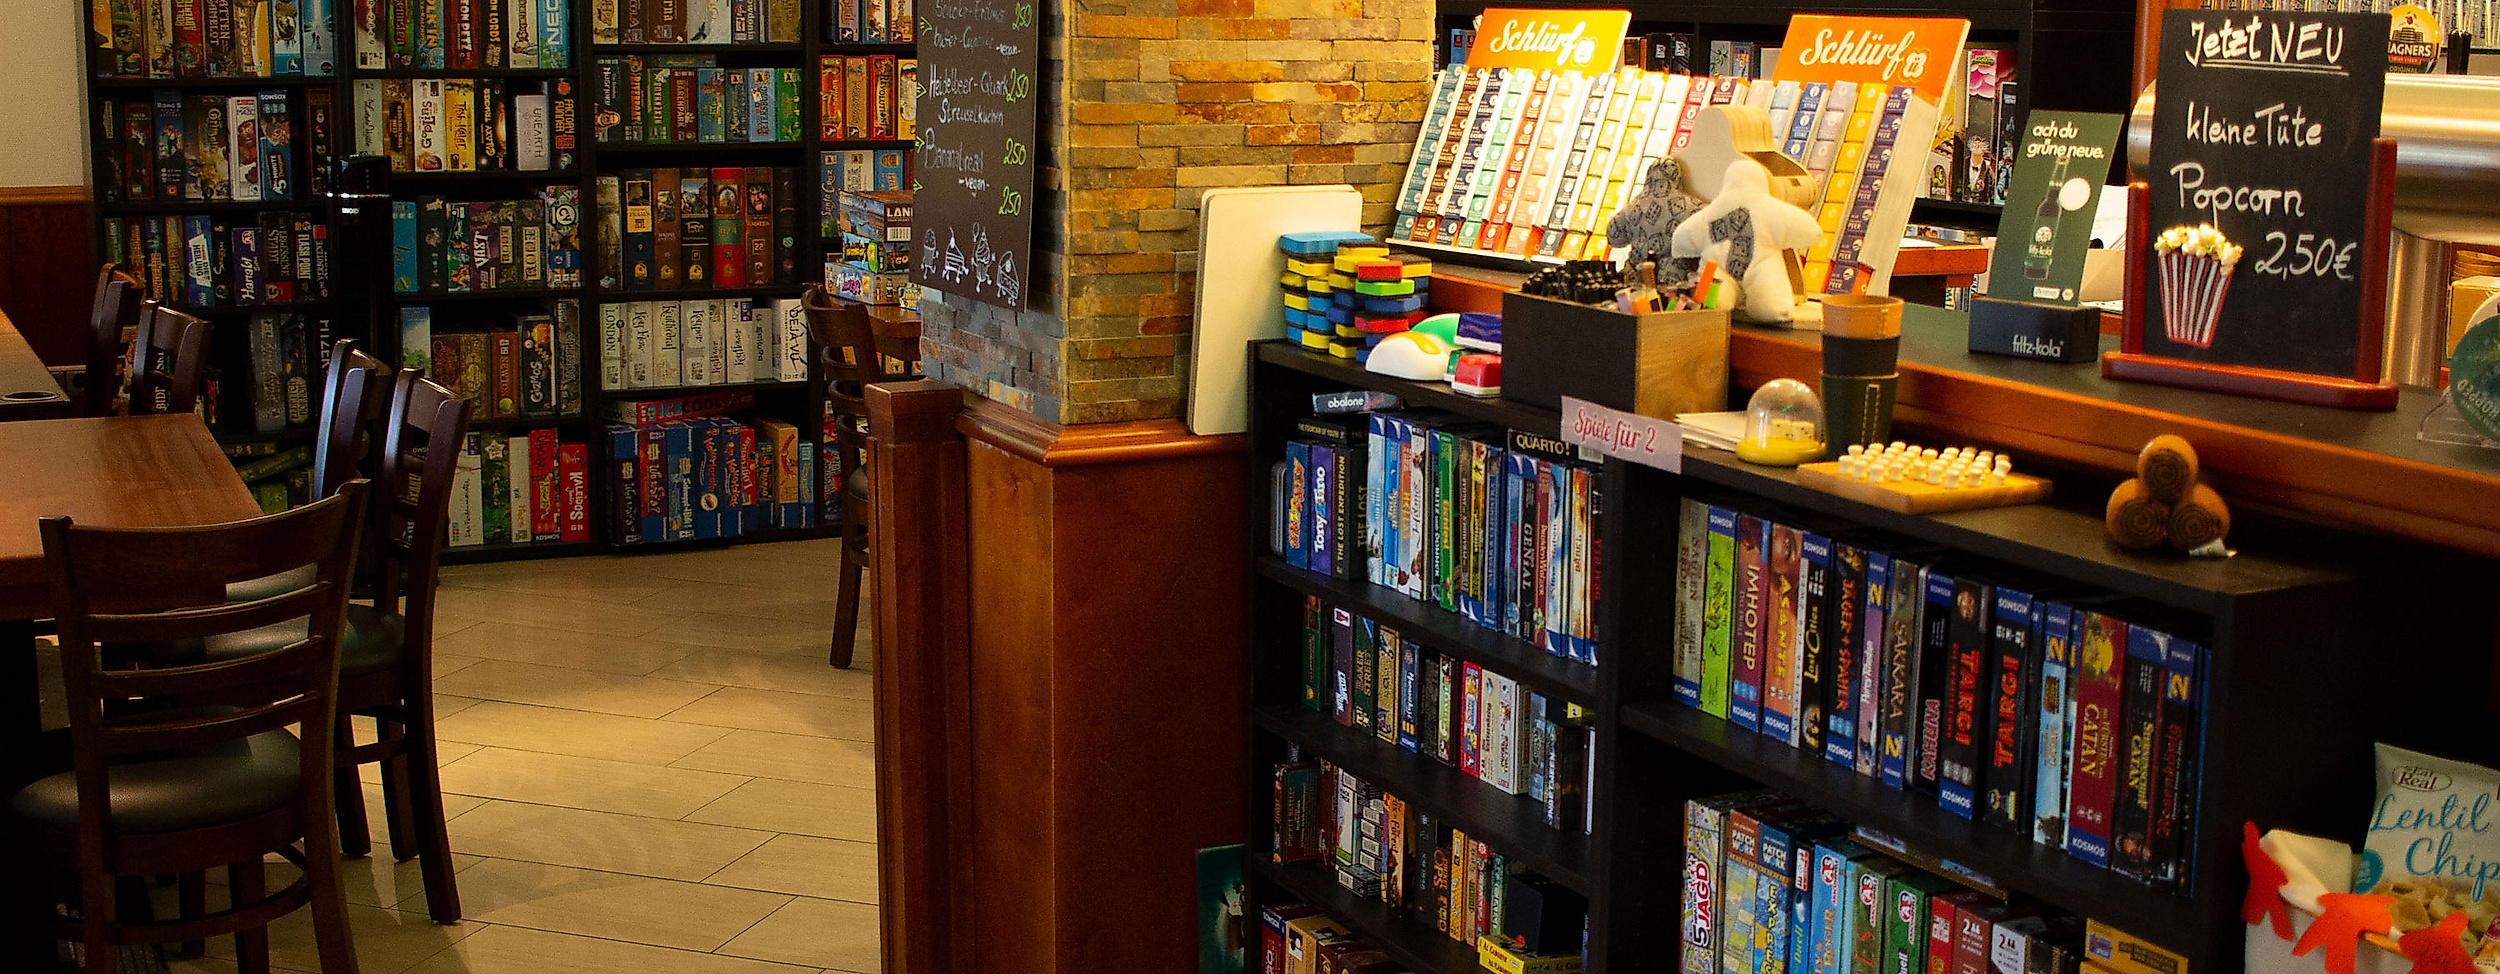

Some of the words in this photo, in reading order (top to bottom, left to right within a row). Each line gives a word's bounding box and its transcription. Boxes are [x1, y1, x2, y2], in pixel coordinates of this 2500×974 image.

[1489, 20, 1586, 73] Schlürf
[1799, 28, 1915, 81] Schlürf
[2185, 16, 2262, 67] Jetzt
[2269, 21, 2344, 63] NEU
[533, 108, 543, 158] UNEARTH
[554, 101, 565, 132] FUNNER
[564, 98, 575, 134] FACTORY
[2032, 122, 2057, 137] ach
[2060, 122, 2079, 138] du
[2186, 101, 2256, 147] kleine
[2256, 103, 2324, 147] Tüte
[2169, 161, 2305, 232] Popcorn
[2254, 232, 2358, 281] 2,50€
[2012, 334, 2062, 359] fritz-kola
[1516, 433, 1571, 456] QUARTO!
[1574, 407, 1612, 446] Spiele
[1613, 423, 1642, 451] für
[1644, 428, 1656, 453] 2
[1314, 466, 1326, 502] Tino
[1338, 456, 1346, 515] EXPEDITION
[1313, 518, 1327, 553] Tony
[1337, 516, 1345, 541] LOST
[1356, 520, 1366, 547] THE
[1336, 542, 1344, 561] THE
[1741, 564, 1760, 671] IMHOTEP
[1998, 598, 2029, 614] KOSMOS
[1773, 575, 1793, 679] ASANTE
[1889, 620, 1908, 719] SAKKARA
[1955, 650, 1980, 746] TARGI
[1993, 654, 2020, 767] TARGI
[1920, 698, 1941, 781] KAHUNA
[2081, 703, 2099, 776] CATAN
[1941, 789, 1972, 809] KOSMOS
[2400, 773, 2437, 791] Real
[2370, 792, 2490, 833] Lentil
[1732, 830, 1756, 847] PATCH
[1763, 842, 1787, 860] PATCH
[2072, 838, 2106, 856] KOSMOS
[1697, 860, 1712, 931] JAGD
[1692, 926, 1709, 947] 5
